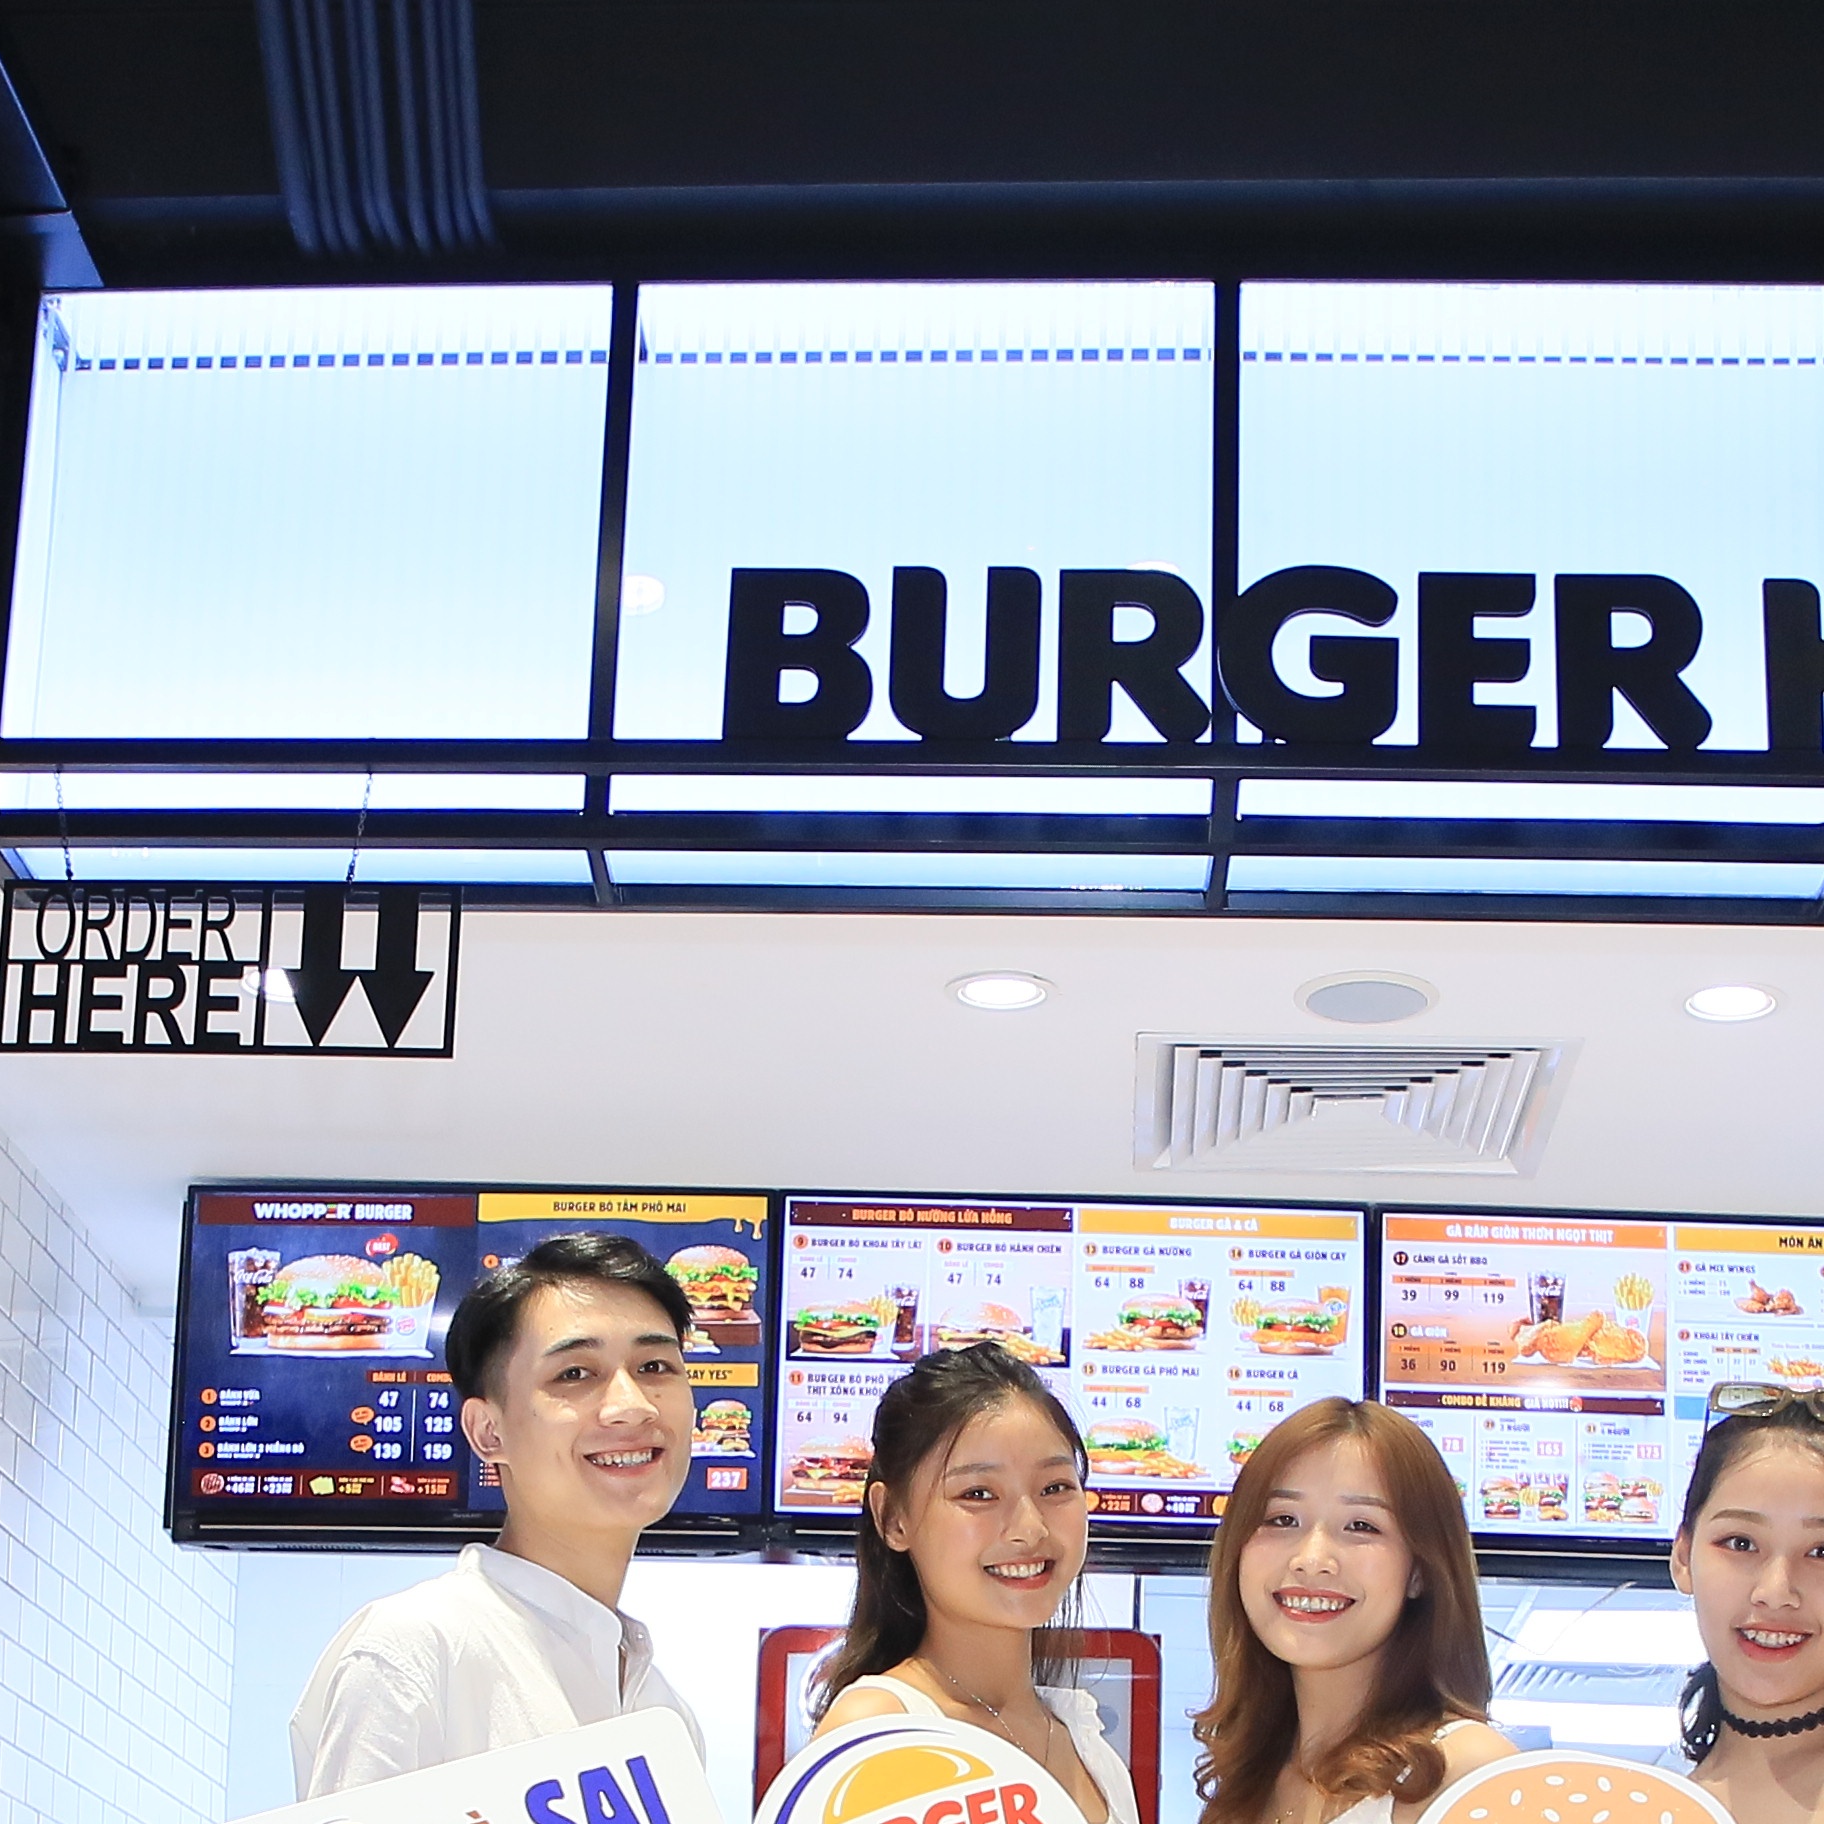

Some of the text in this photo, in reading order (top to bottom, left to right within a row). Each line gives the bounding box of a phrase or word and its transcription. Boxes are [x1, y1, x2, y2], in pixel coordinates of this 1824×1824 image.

[724, 566, 1712, 752] BURGER
[36, 892, 238, 962] ORDER
[20, 963, 245, 1047] HERE
[354, 1203, 413, 1221] BURGER
[554, 1201, 596, 1212] BURGER
[642, 1200, 663, 1213] PHÔ
[667, 1202, 687, 1213] MAI
[852, 1209, 897, 1222] BURGER
[1169, 1217, 1215, 1231] BURGER
[811, 1239, 846, 1248] BURGER
[956, 1242, 993, 1252] BURGER
[1778, 1235, 1804, 1249] MÓN
[1102, 1245, 1140, 1255] BURGER
[1248, 1249, 1287, 1260] BURGER
[1330, 1251, 1346, 1261] CAY
[800, 1266, 816, 1279] 47
[837, 1266, 854, 1279] 74
[947, 1272, 963, 1284] 47
[986, 1273, 1002, 1285] 74
[1094, 1277, 1110, 1288] 64
[1128, 1277, 1145, 1289] 88
[1238, 1279, 1254, 1291] 64
[1270, 1280, 1286, 1292] 88
[1401, 1289, 1417, 1301] 39
[1444, 1289, 1460, 1301] 99
[1483, 1292, 1505, 1304] 119
[1101, 1364, 1140, 1375] BURGER
[1400, 1358, 1417, 1371] 36
[1440, 1359, 1457, 1372] 90
[1482, 1361, 1506, 1374] 119
[806, 1373, 846, 1384] BURGER
[1245, 1369, 1285, 1380] BURGER
[378, 1390, 399, 1408] 47
[428, 1391, 450, 1409] 74
[1091, 1397, 1107, 1408] 44
[1125, 1397, 1142, 1409] 68
[1236, 1400, 1252, 1412] 44
[1268, 1400, 1285, 1413] 68
[796, 1411, 812, 1424] 64
[833, 1412, 849, 1424] 94
[373, 1415, 403, 1434] 105
[423, 1415, 454, 1434] 125
[372, 1442, 402, 1460] 139
[422, 1442, 453, 1460] 159
[710, 1470, 741, 1489] 237
